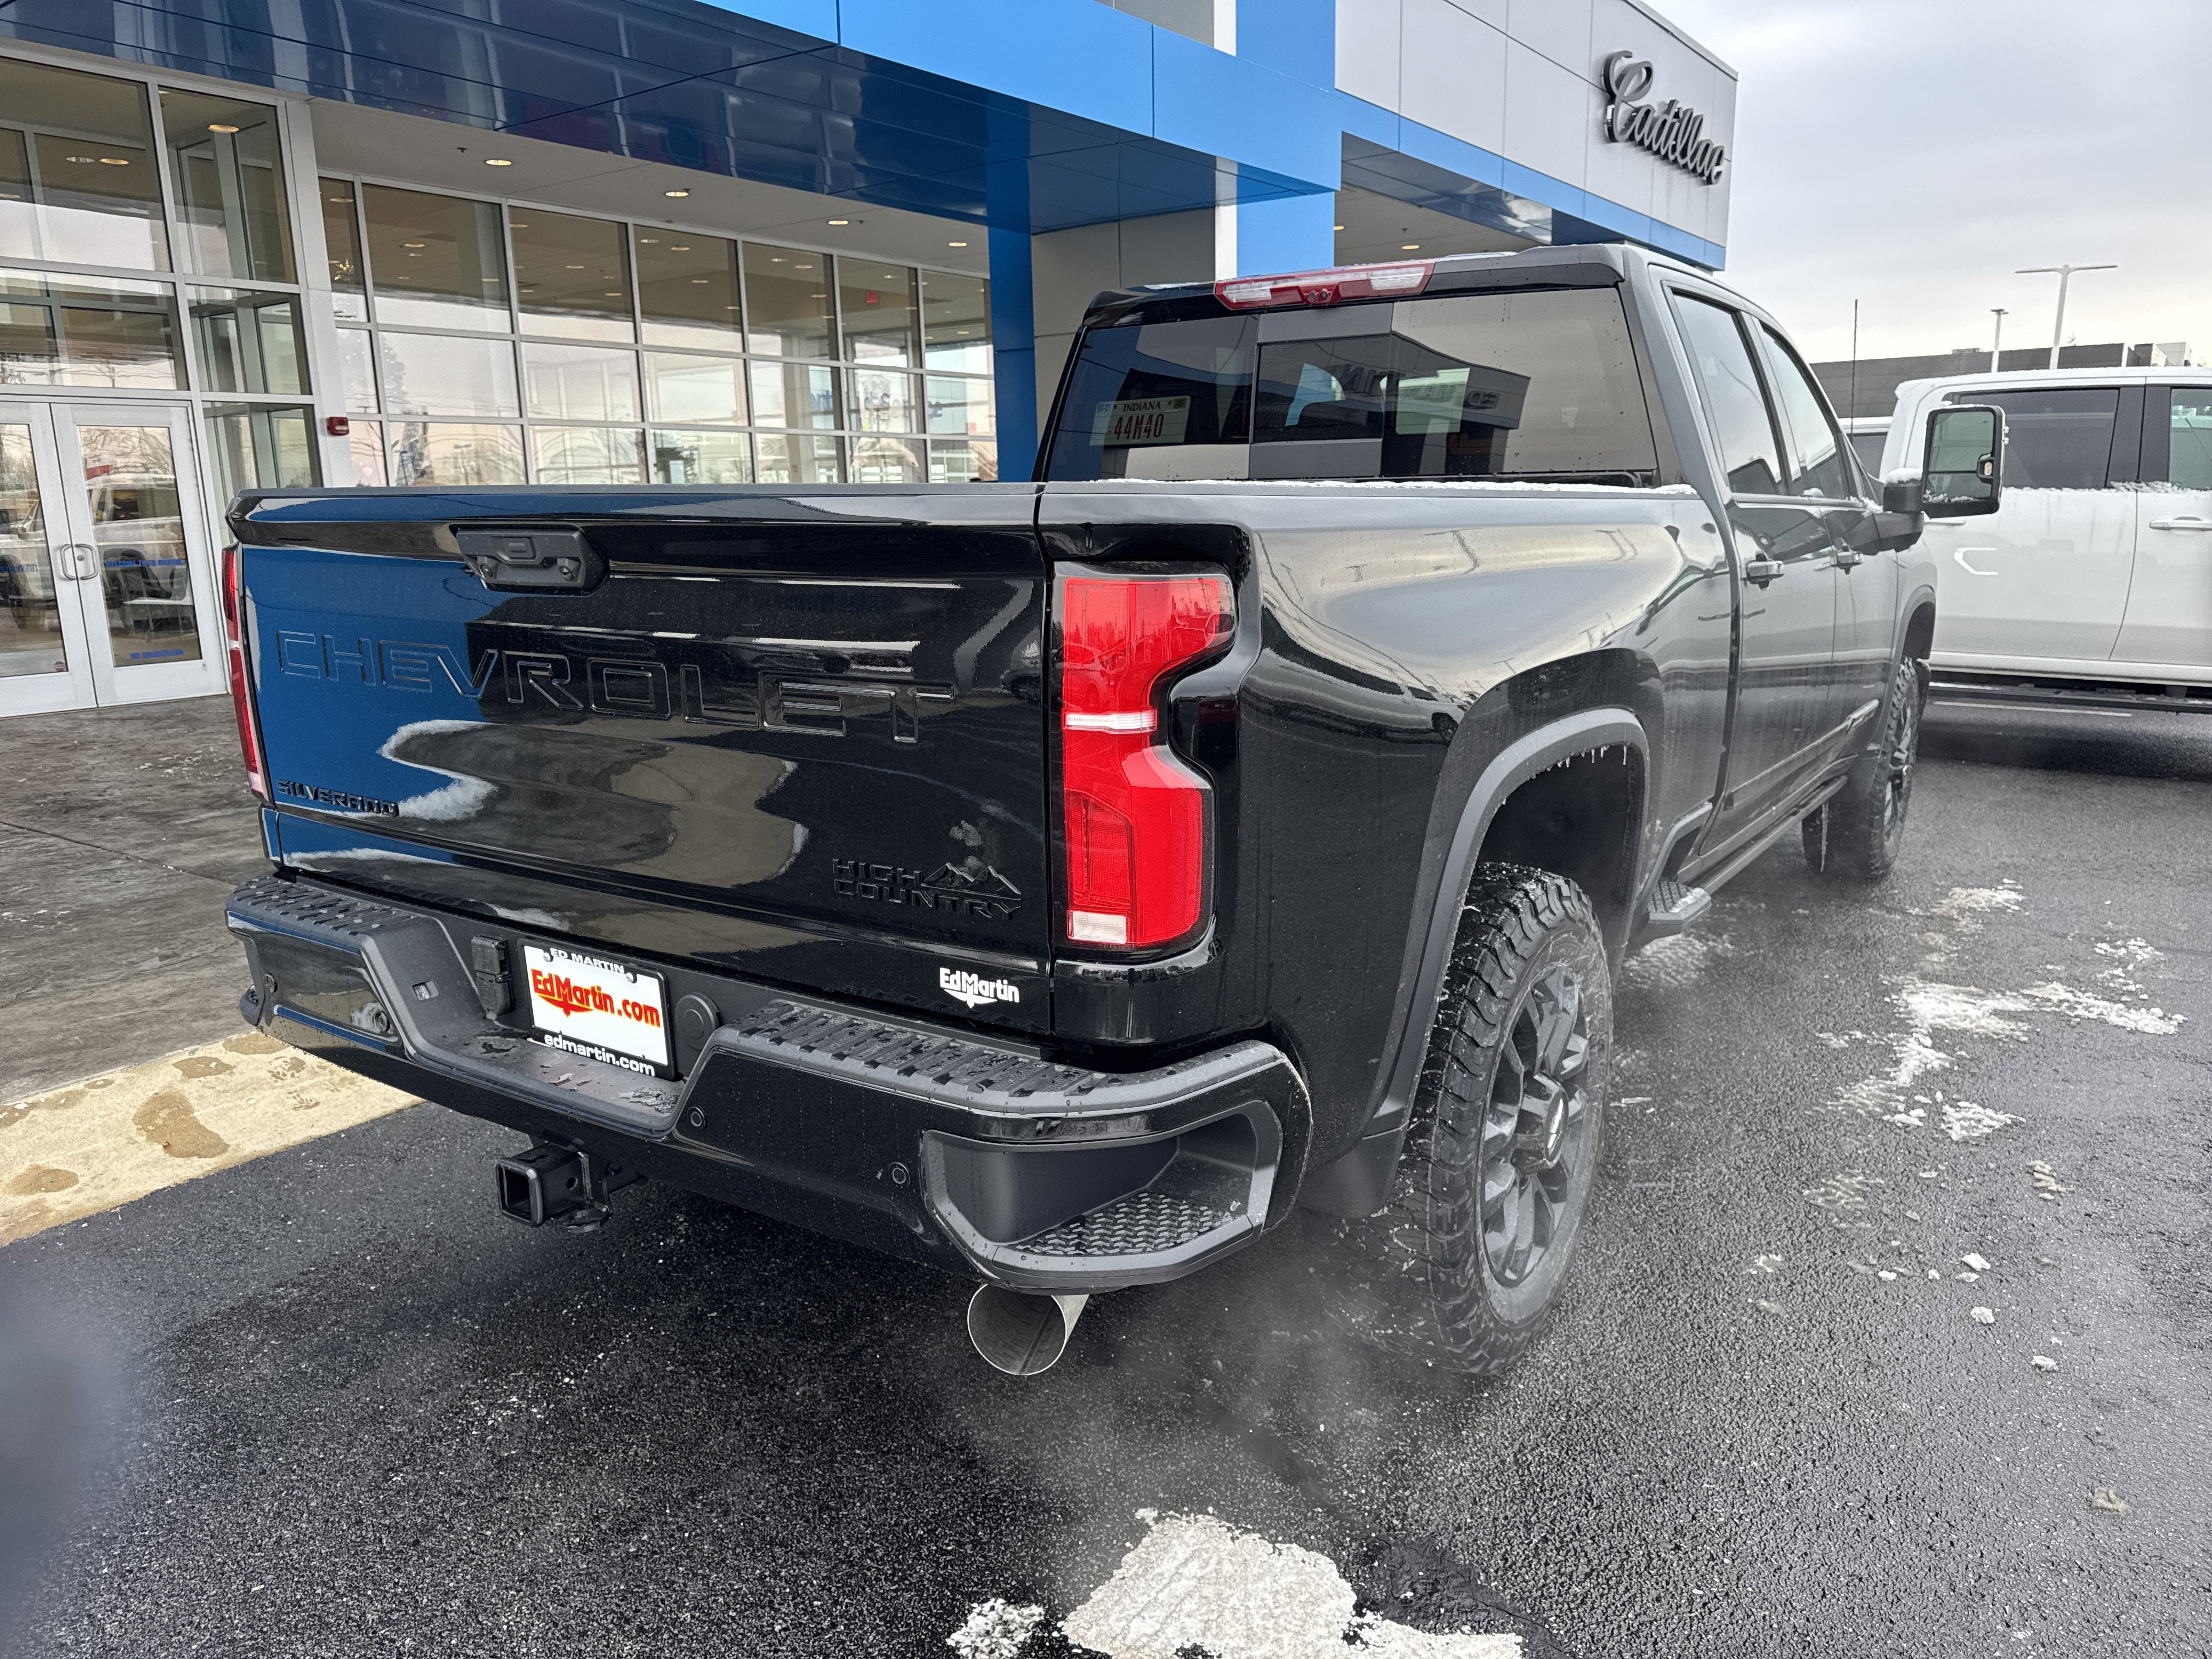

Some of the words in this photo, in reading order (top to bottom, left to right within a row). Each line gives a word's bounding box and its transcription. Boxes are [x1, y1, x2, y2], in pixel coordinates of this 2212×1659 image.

[1602, 50, 1724, 185] Cadillac
[1124, 401, 1161, 411] INDIANA
[276, 630, 955, 743] CHEVROLET
[278, 778, 399, 817] SILVERADO
[833, 858, 923, 887] HIGH
[834, 879, 1022, 921] COUNTRY
[550, 948, 568, 959] ED
[571, 953, 624, 974] MARTIN
[940, 967, 1019, 1003] EdMartin
[544, 1034, 655, 1077] edmartin.com
